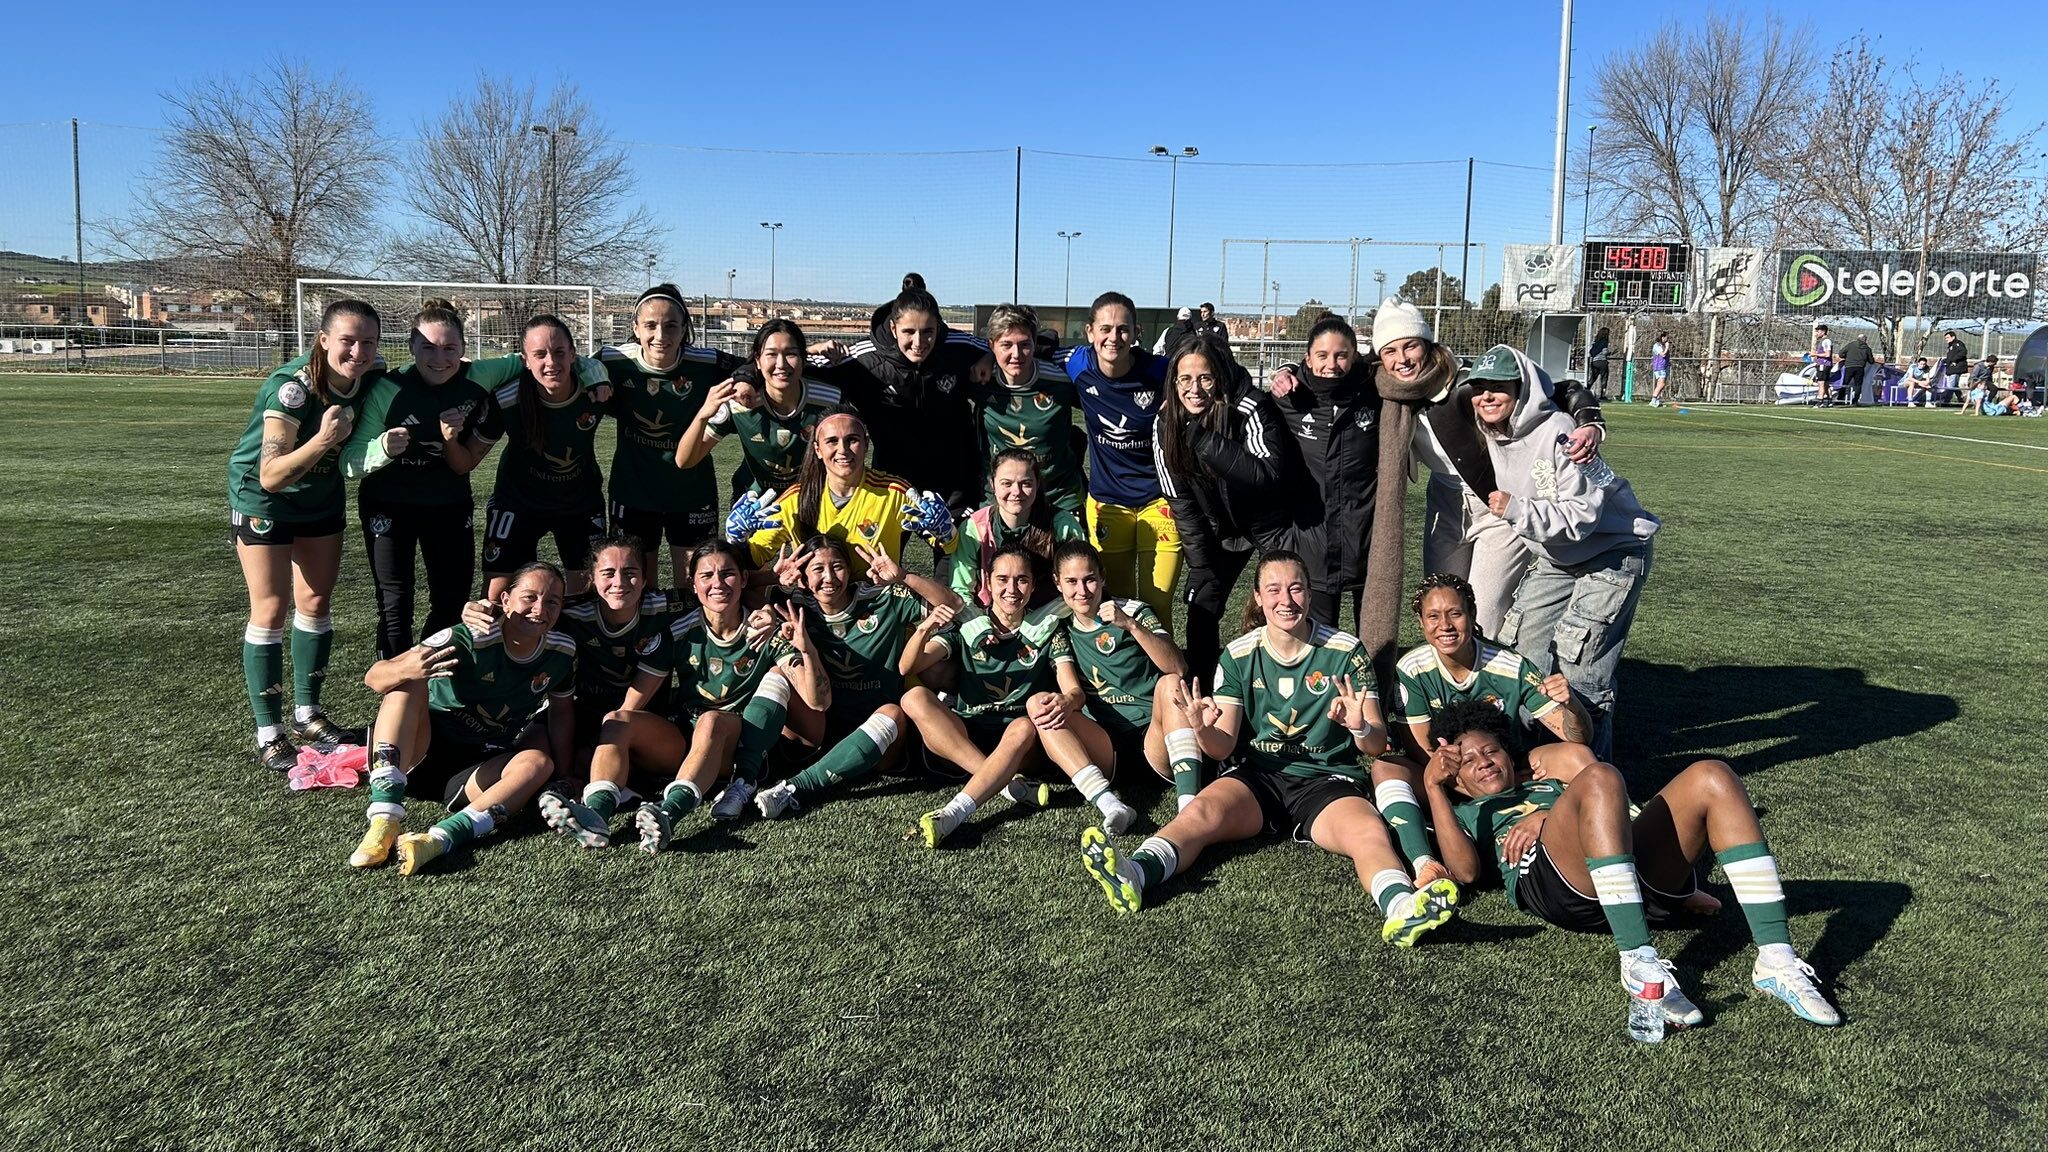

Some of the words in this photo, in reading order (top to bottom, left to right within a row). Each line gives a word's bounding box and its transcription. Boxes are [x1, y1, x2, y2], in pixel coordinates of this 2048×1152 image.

[1608, 248, 1666, 269] 45:00
[1601, 281, 1615, 304] 2
[1673, 284, 1680, 304] 1
[1837, 263, 2030, 302] teleporte
[488, 509, 515, 539] 10
